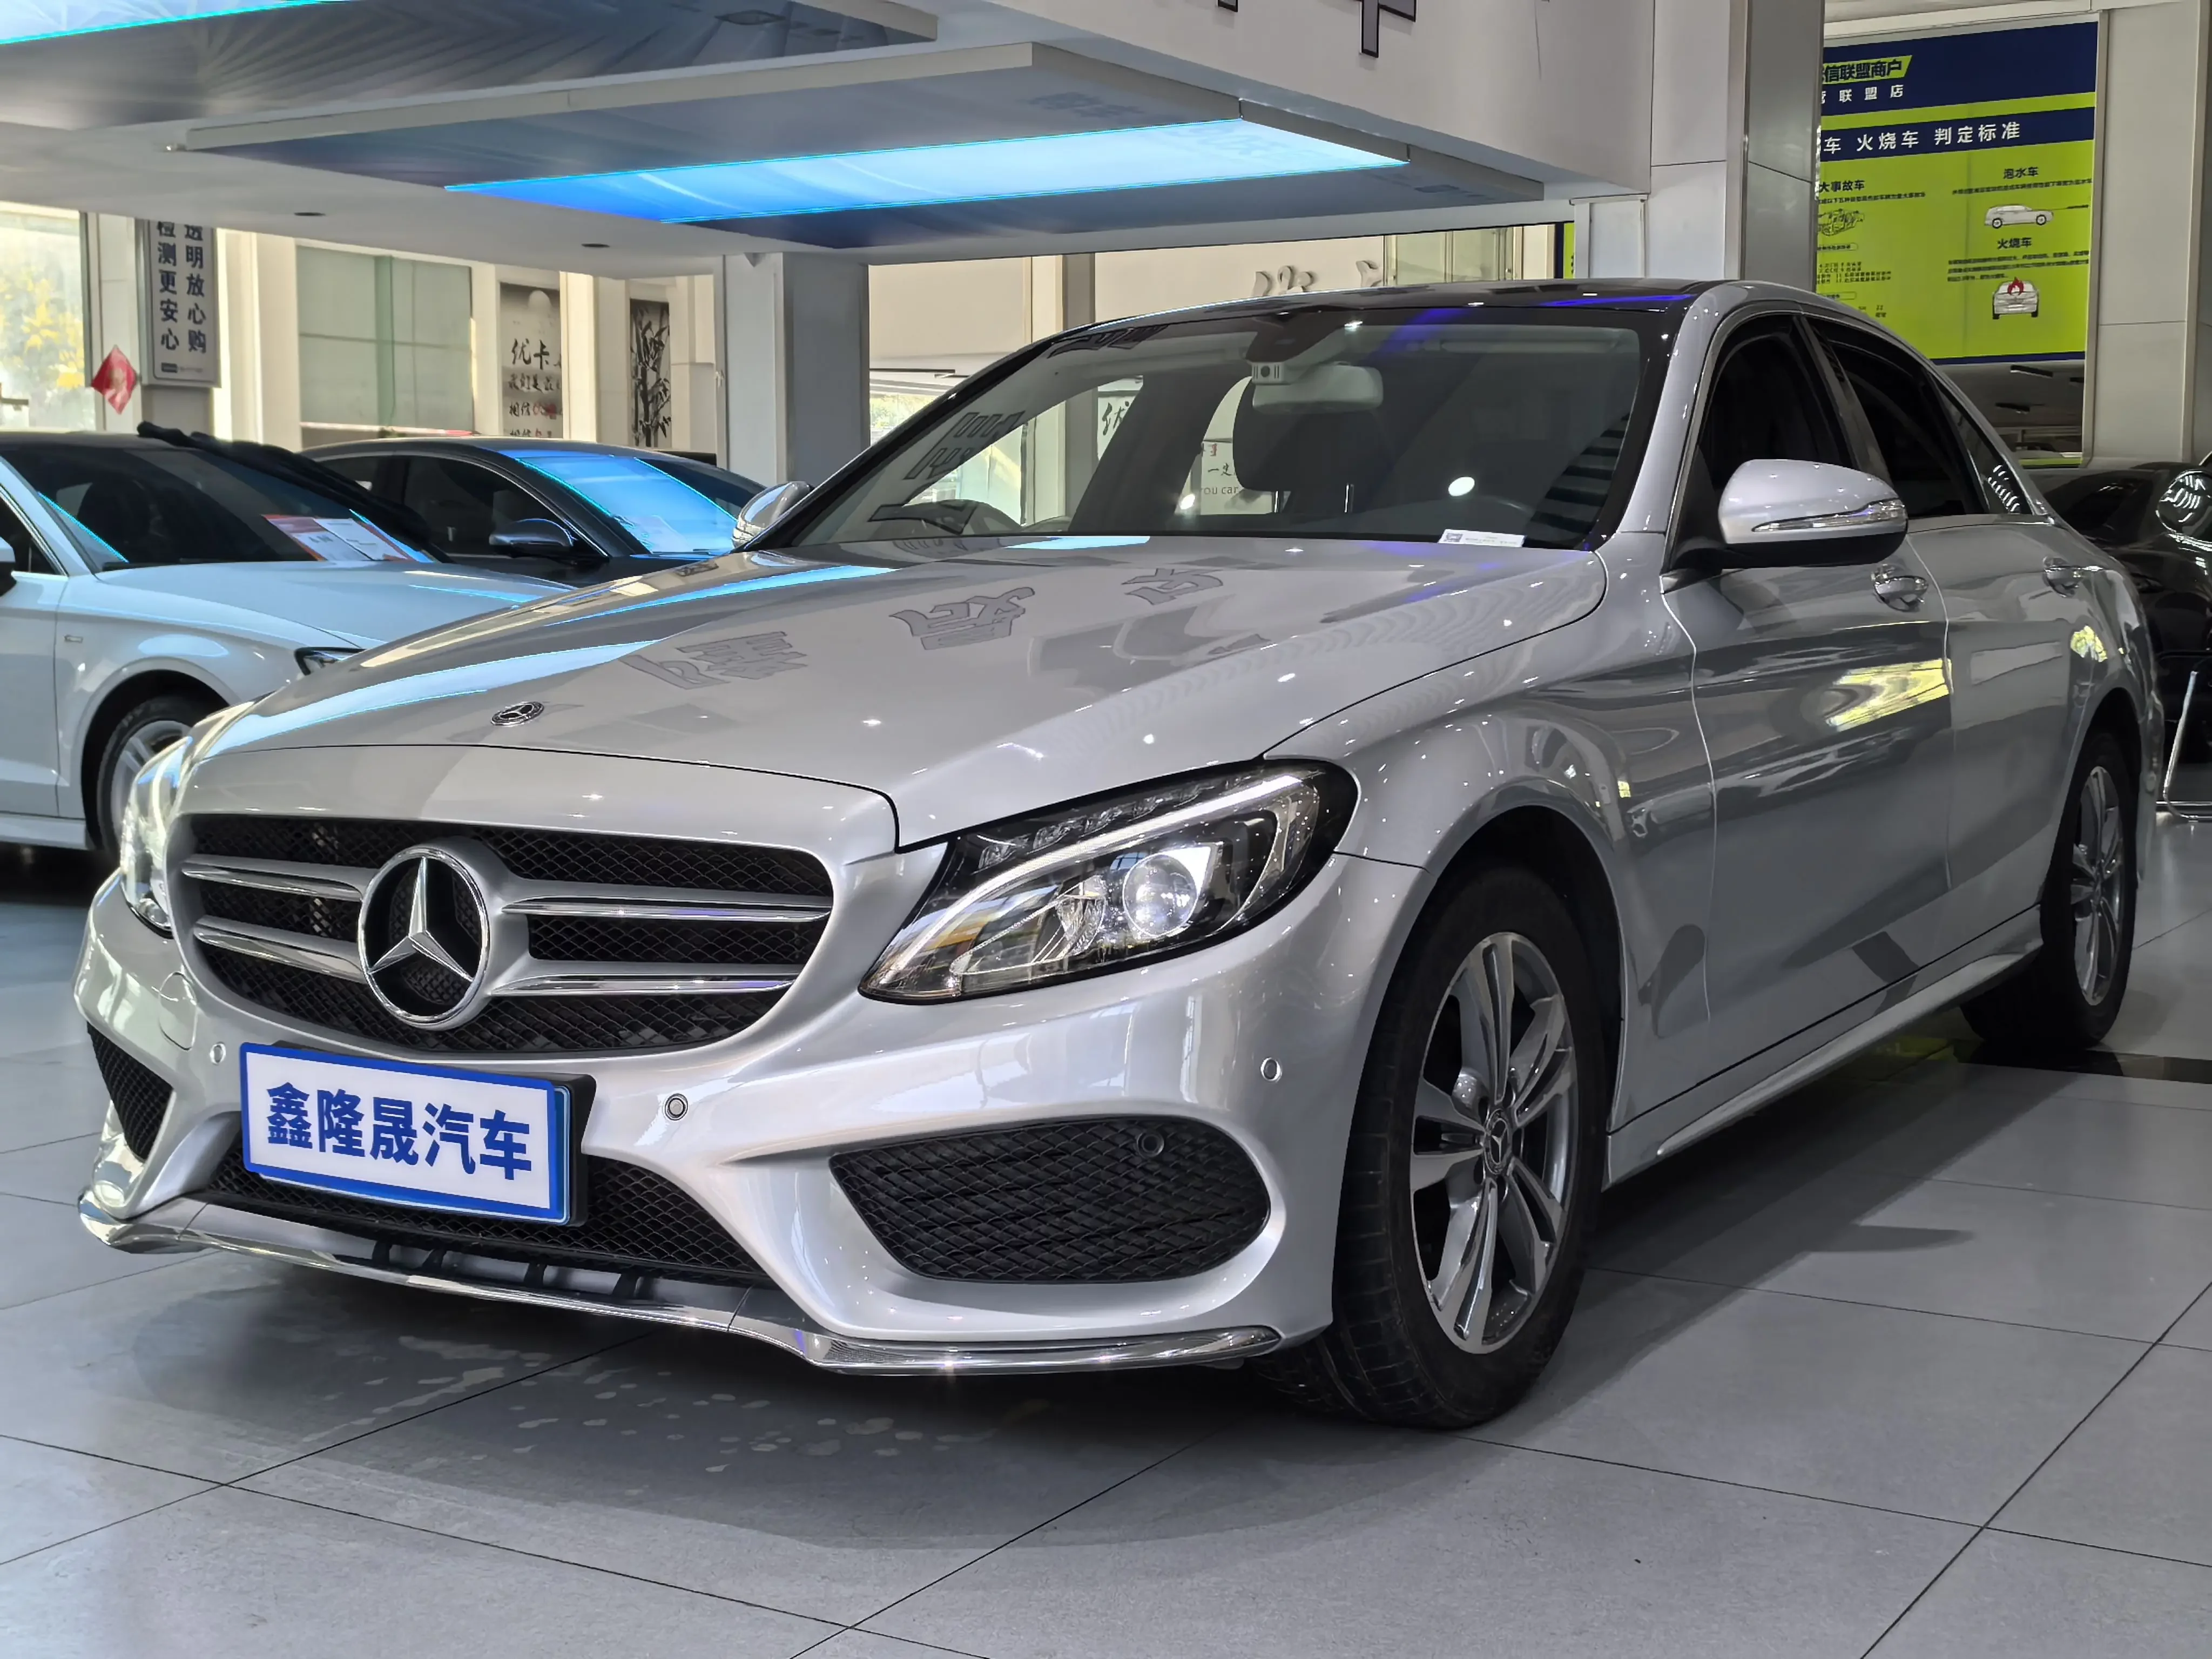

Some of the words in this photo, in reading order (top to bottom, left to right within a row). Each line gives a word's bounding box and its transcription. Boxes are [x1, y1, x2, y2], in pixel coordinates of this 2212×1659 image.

[1823, 58, 1901, 83] 信联盟商户
[1823, 137, 1842, 154] 车
[1856, 130, 1919, 152] 火烧车
[1934, 121, 2021, 145] 判定标准
[2003, 166, 2039, 179] 泡水车
[1818, 180, 1865, 193] 大事故车
[1997, 237, 2032, 249] 火烧车
[266, 1082, 532, 1181] 鑫隆晟汽车
